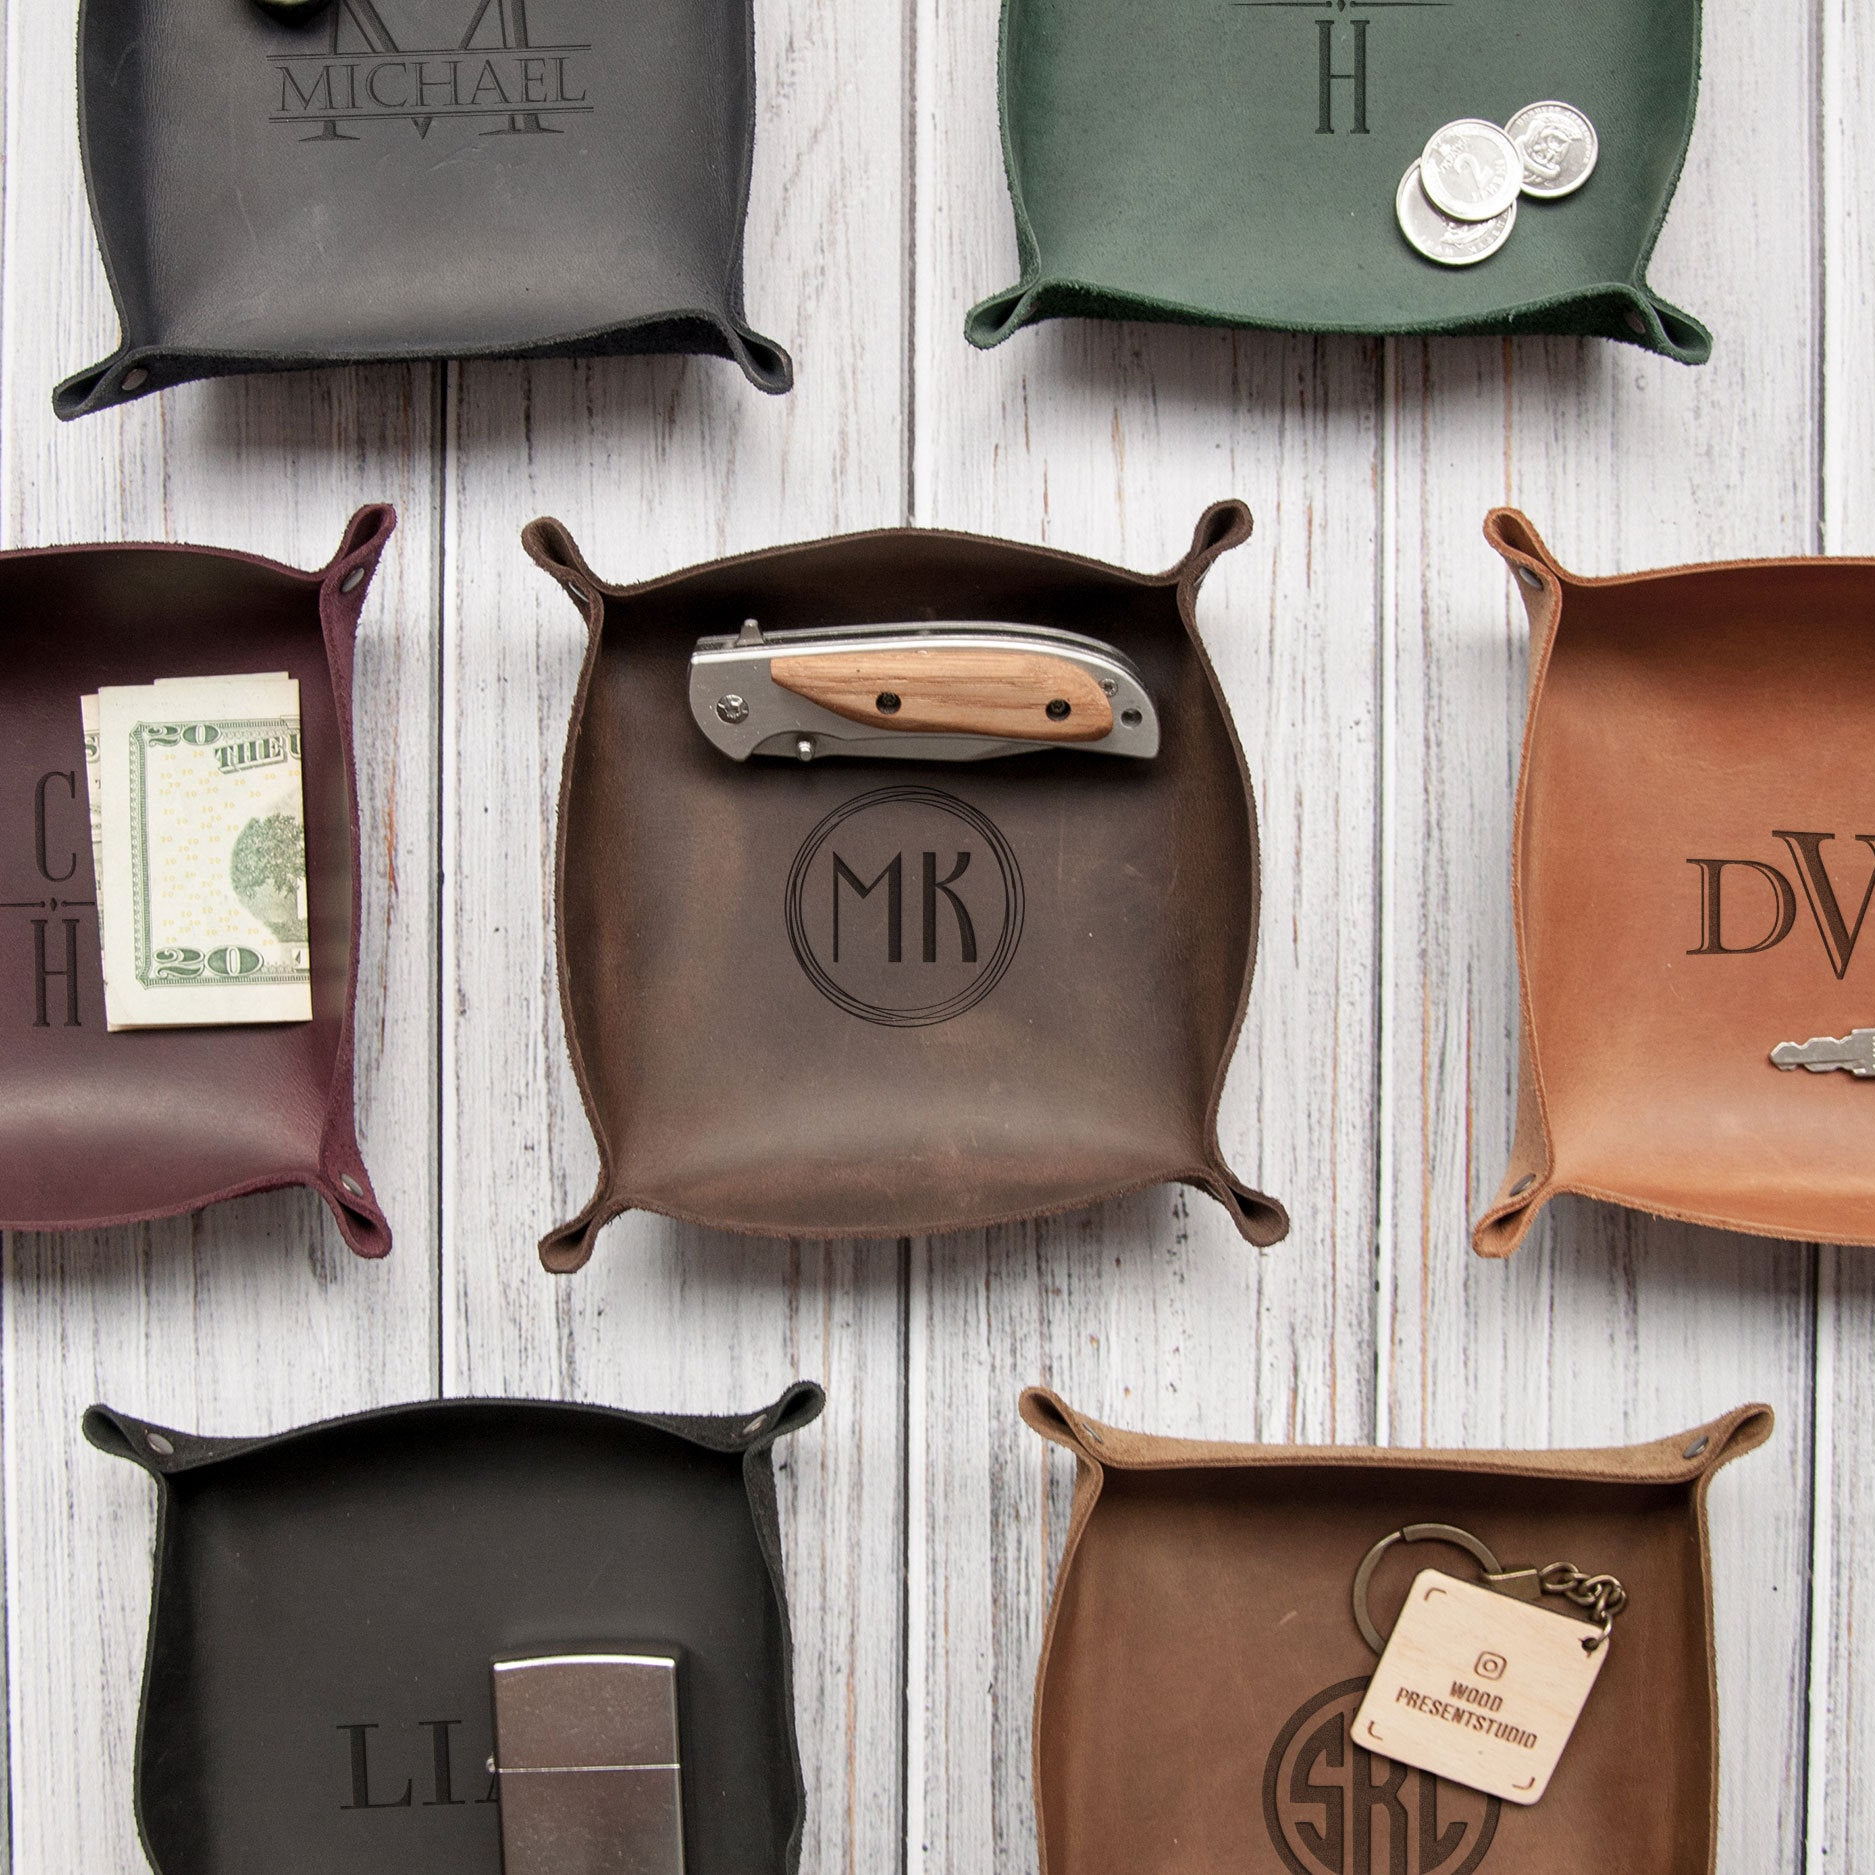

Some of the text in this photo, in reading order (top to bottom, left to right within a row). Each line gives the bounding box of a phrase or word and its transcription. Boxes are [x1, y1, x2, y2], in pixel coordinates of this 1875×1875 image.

[275, 57, 587, 111] MICHAEL
[1315, 20, 1370, 134] H
[147, 723, 221, 747] 20
[214, 736, 287, 774] THE
[35, 771, 76, 882] C
[833, 851, 977, 963] MK
[31, 919, 81, 1026] H
[154, 945, 264, 979] 20
[1395, 1687, 1538, 1749] PRESENTSTUDIO
[1450, 1680, 1503, 1712] WOOD
